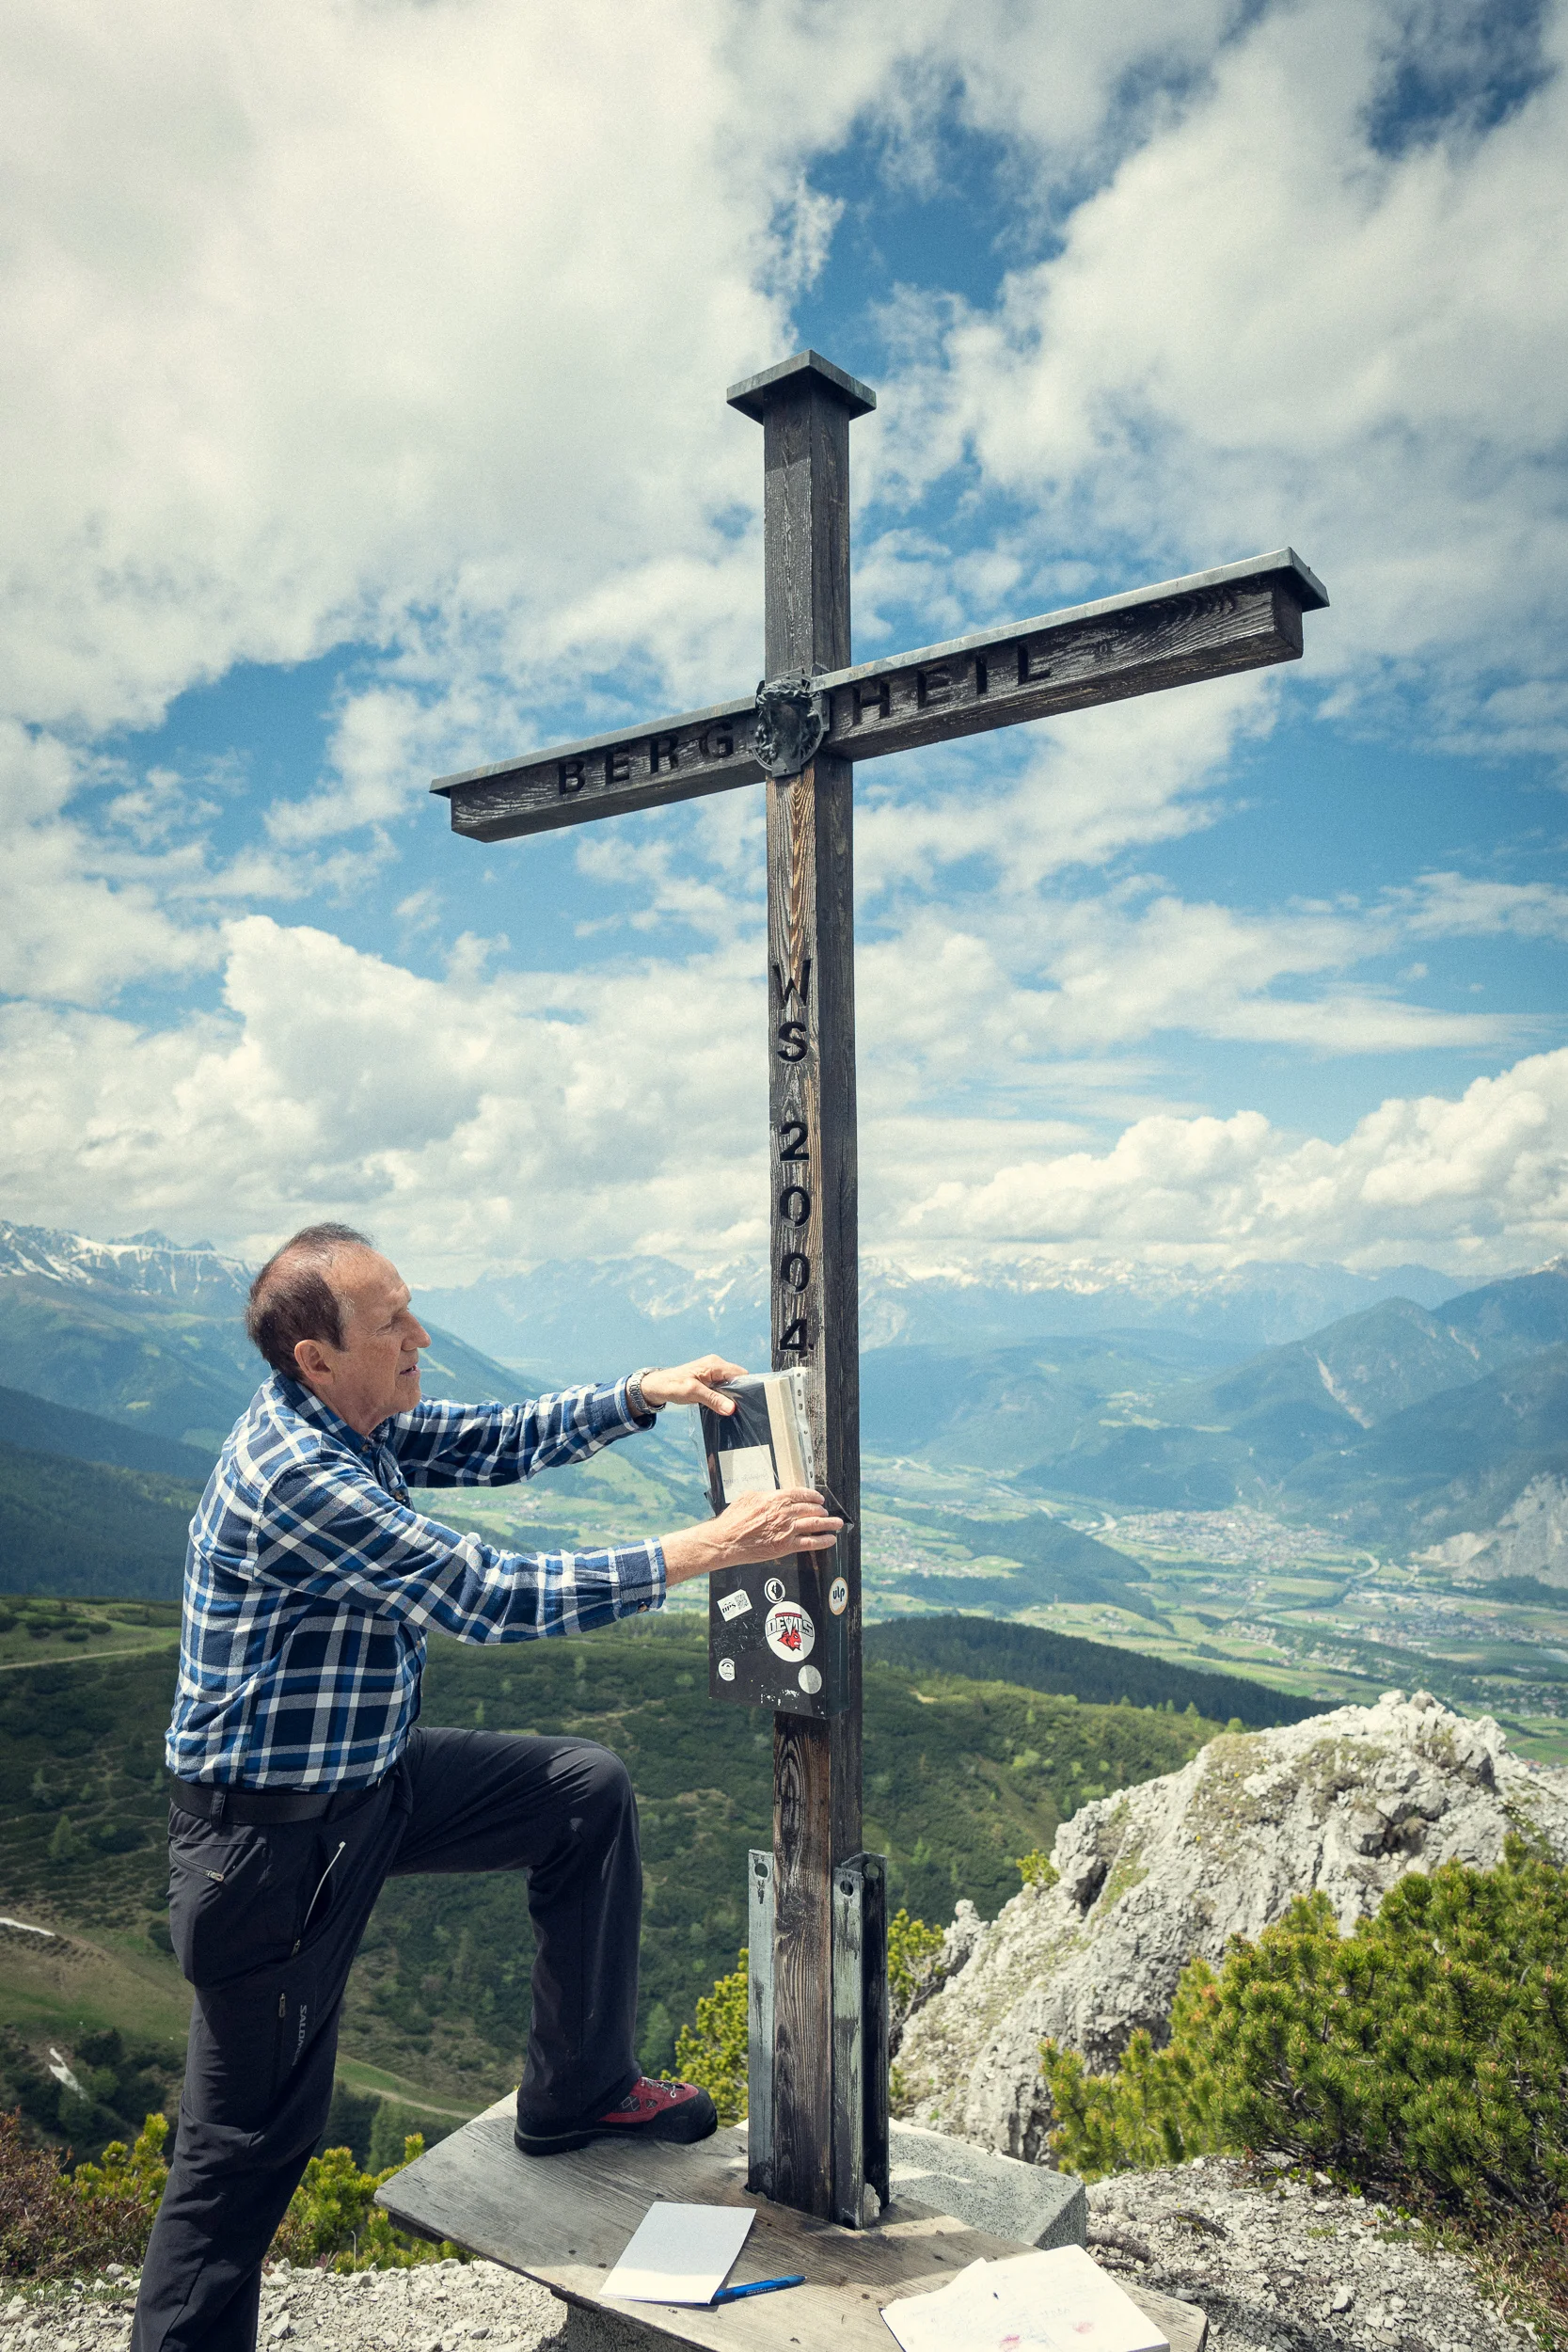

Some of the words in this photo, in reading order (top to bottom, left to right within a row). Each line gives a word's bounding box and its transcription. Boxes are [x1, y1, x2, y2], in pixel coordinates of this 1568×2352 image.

[559, 720, 734, 796] BERG
[852, 642, 1051, 726] HEIL
[780, 1120, 812, 1357] 2004
[766, 1615, 814, 1638] DEVILS
